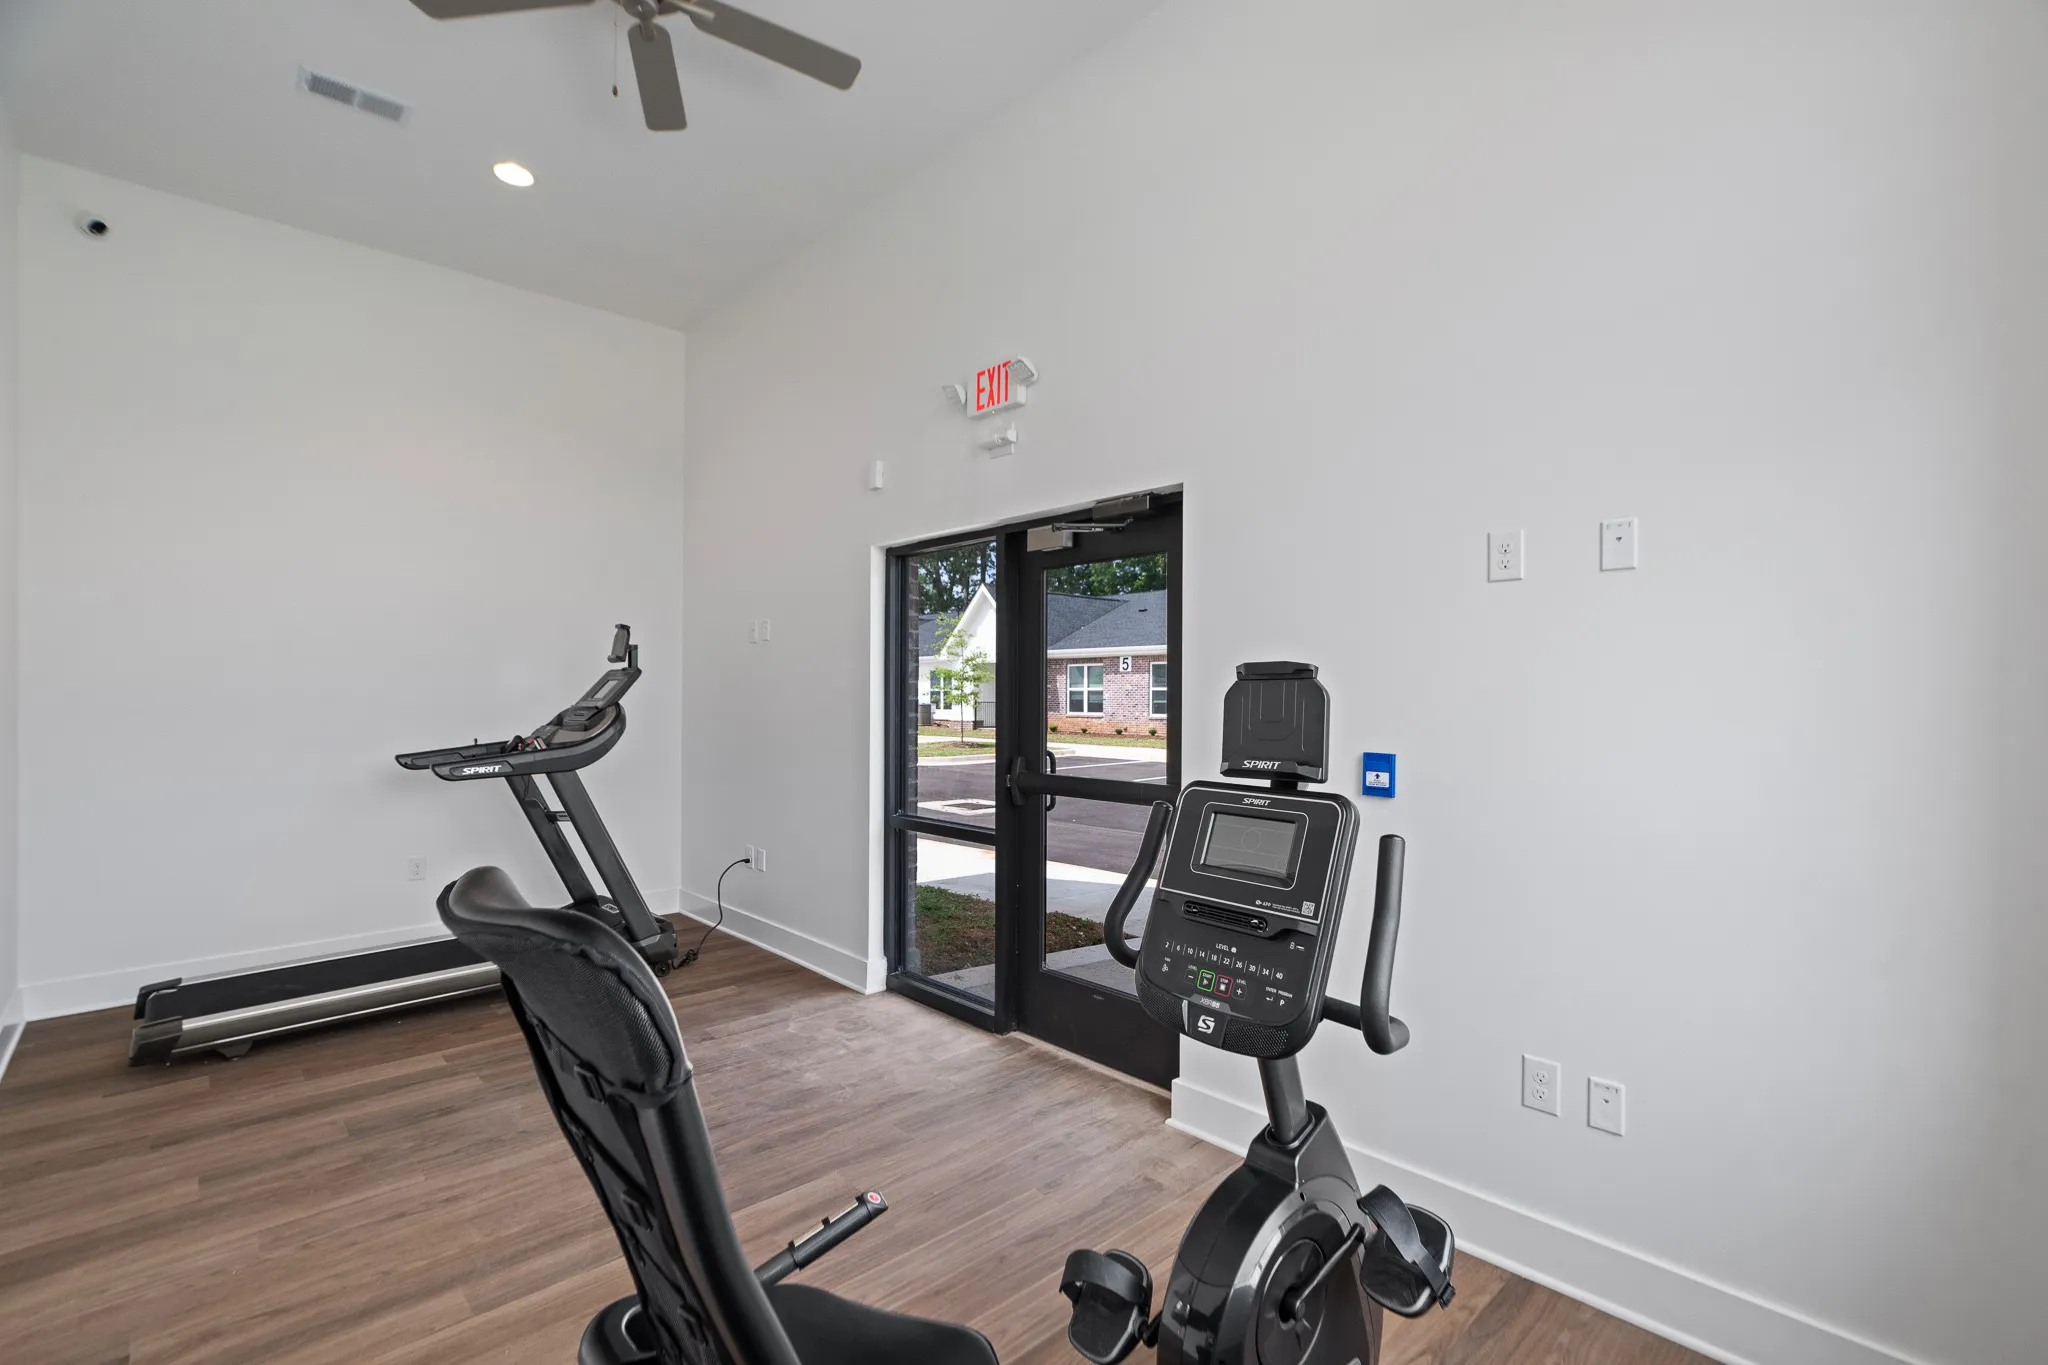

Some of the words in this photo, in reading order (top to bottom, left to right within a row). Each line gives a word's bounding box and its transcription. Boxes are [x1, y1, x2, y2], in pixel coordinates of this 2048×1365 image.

[976, 359, 1012, 412] EXIT
[1122, 657, 1129, 671] 5
[461, 764, 502, 775] SPIRIT
[1241, 759, 1282, 770] SPIRIT
[1241, 797, 1272, 806] SPIRIT
[1215, 943, 1230, 952] LEVEL
[1187, 947, 1194, 955] 10
[1199, 950, 1205, 958] 14
[1223, 957, 1230, 965] 22
[1235, 961, 1243, 969] 26
[1248, 964, 1256, 972] 30
[1262, 968, 1269, 976] 34
[1275, 972, 1284, 980] 40
